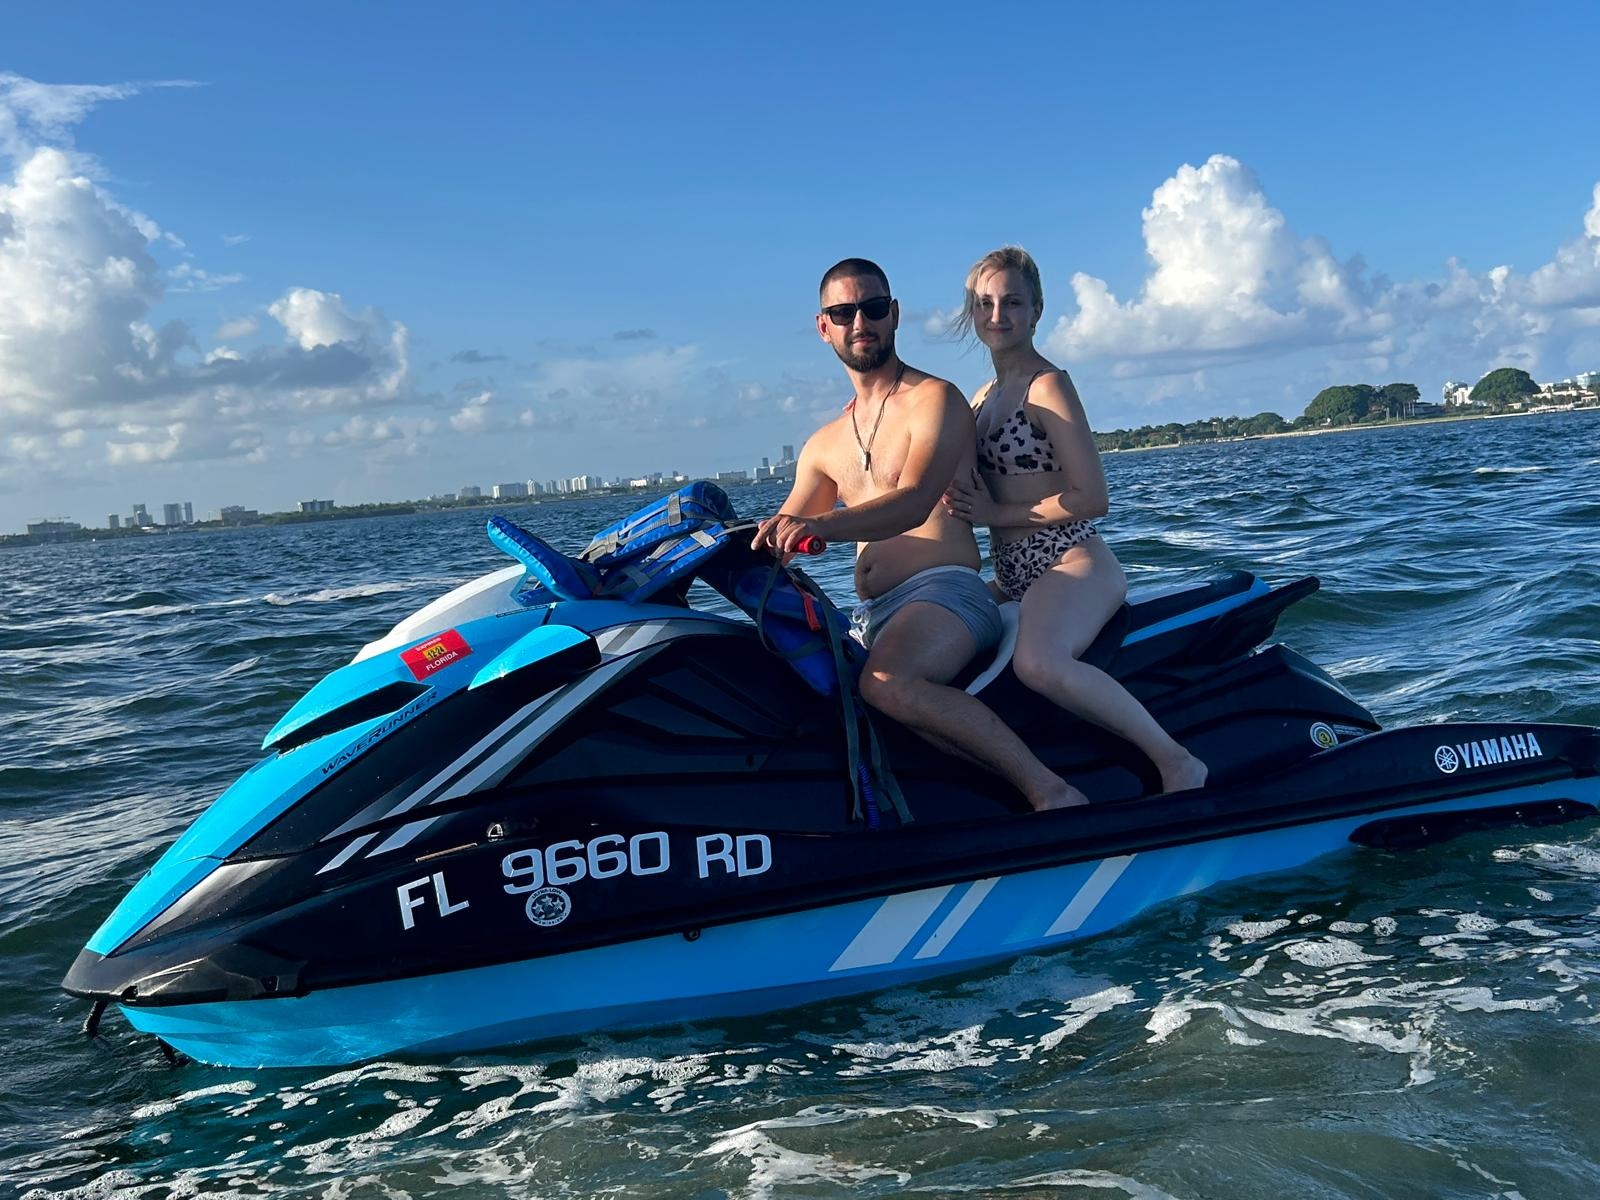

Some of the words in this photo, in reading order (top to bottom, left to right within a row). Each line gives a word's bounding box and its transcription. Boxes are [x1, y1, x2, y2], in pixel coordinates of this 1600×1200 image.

[425, 651, 458, 671] FLORIDA
[321, 691, 438, 774] WAVERUNNER
[1456, 732, 1542, 768] YAMAHA
[397, 871, 470, 931] FL
[501, 831, 670, 895] 9660
[696, 833, 772, 879] RD
